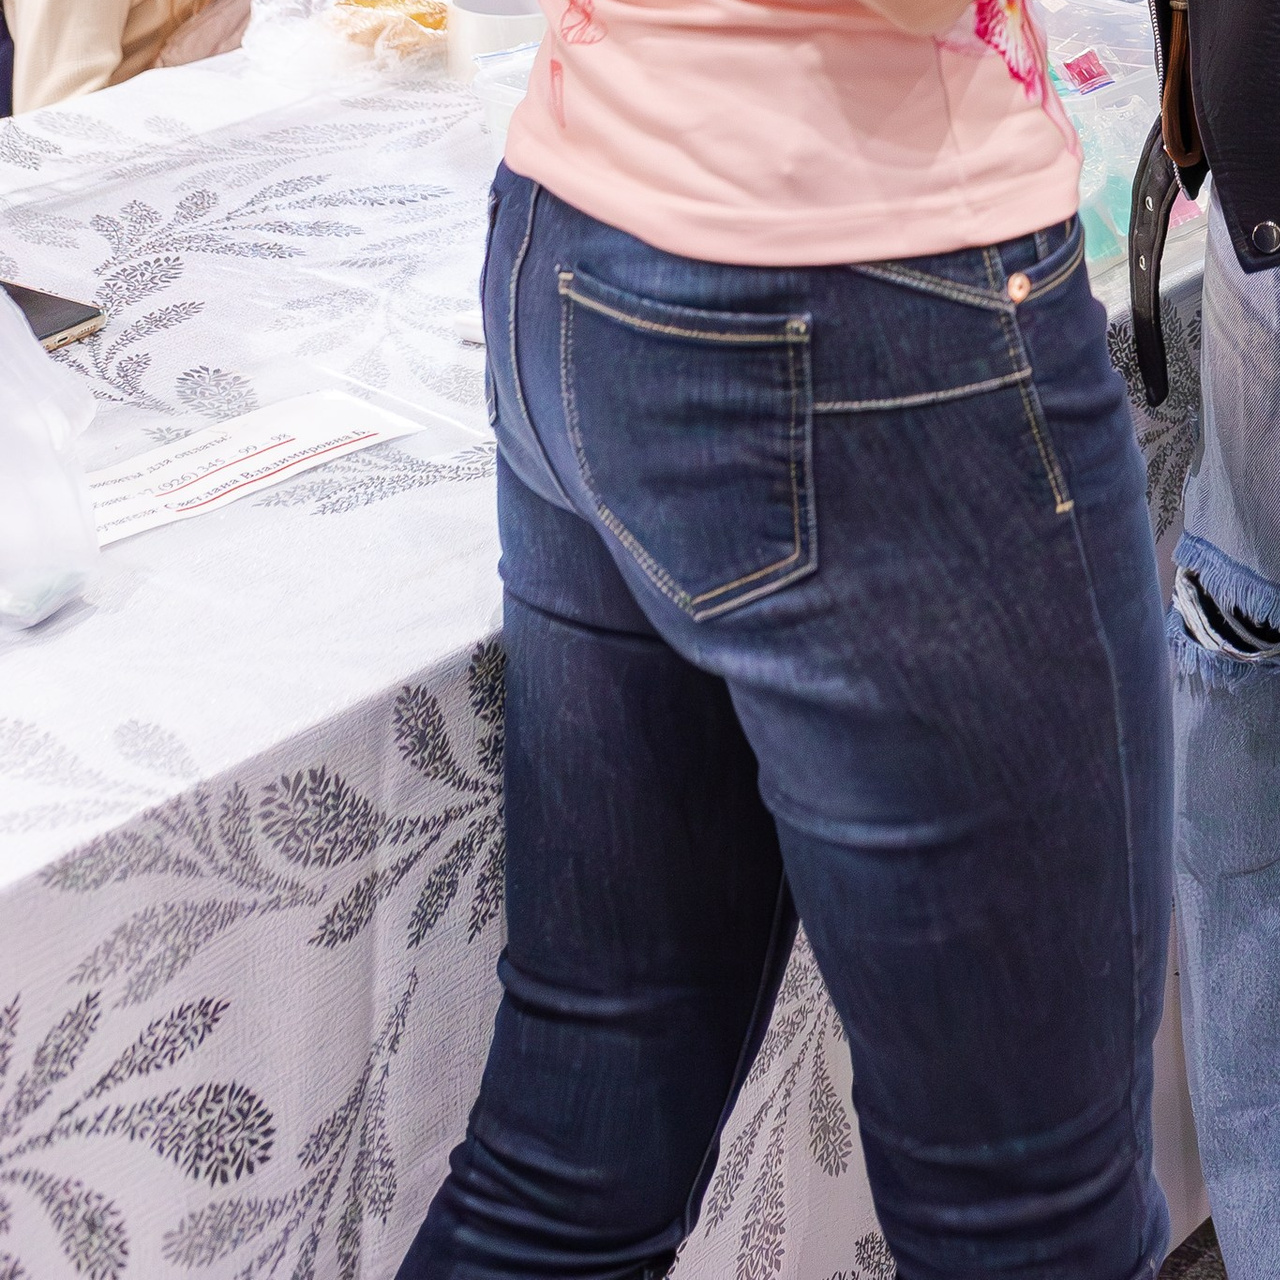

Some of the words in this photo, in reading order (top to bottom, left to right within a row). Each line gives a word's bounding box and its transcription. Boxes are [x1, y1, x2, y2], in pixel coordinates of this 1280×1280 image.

[158, 472, 198, 492] (926)
[197, 458, 226, 474] 345
[239, 444, 257, 455] 99
[241, 435, 352, 479] Владимировна
